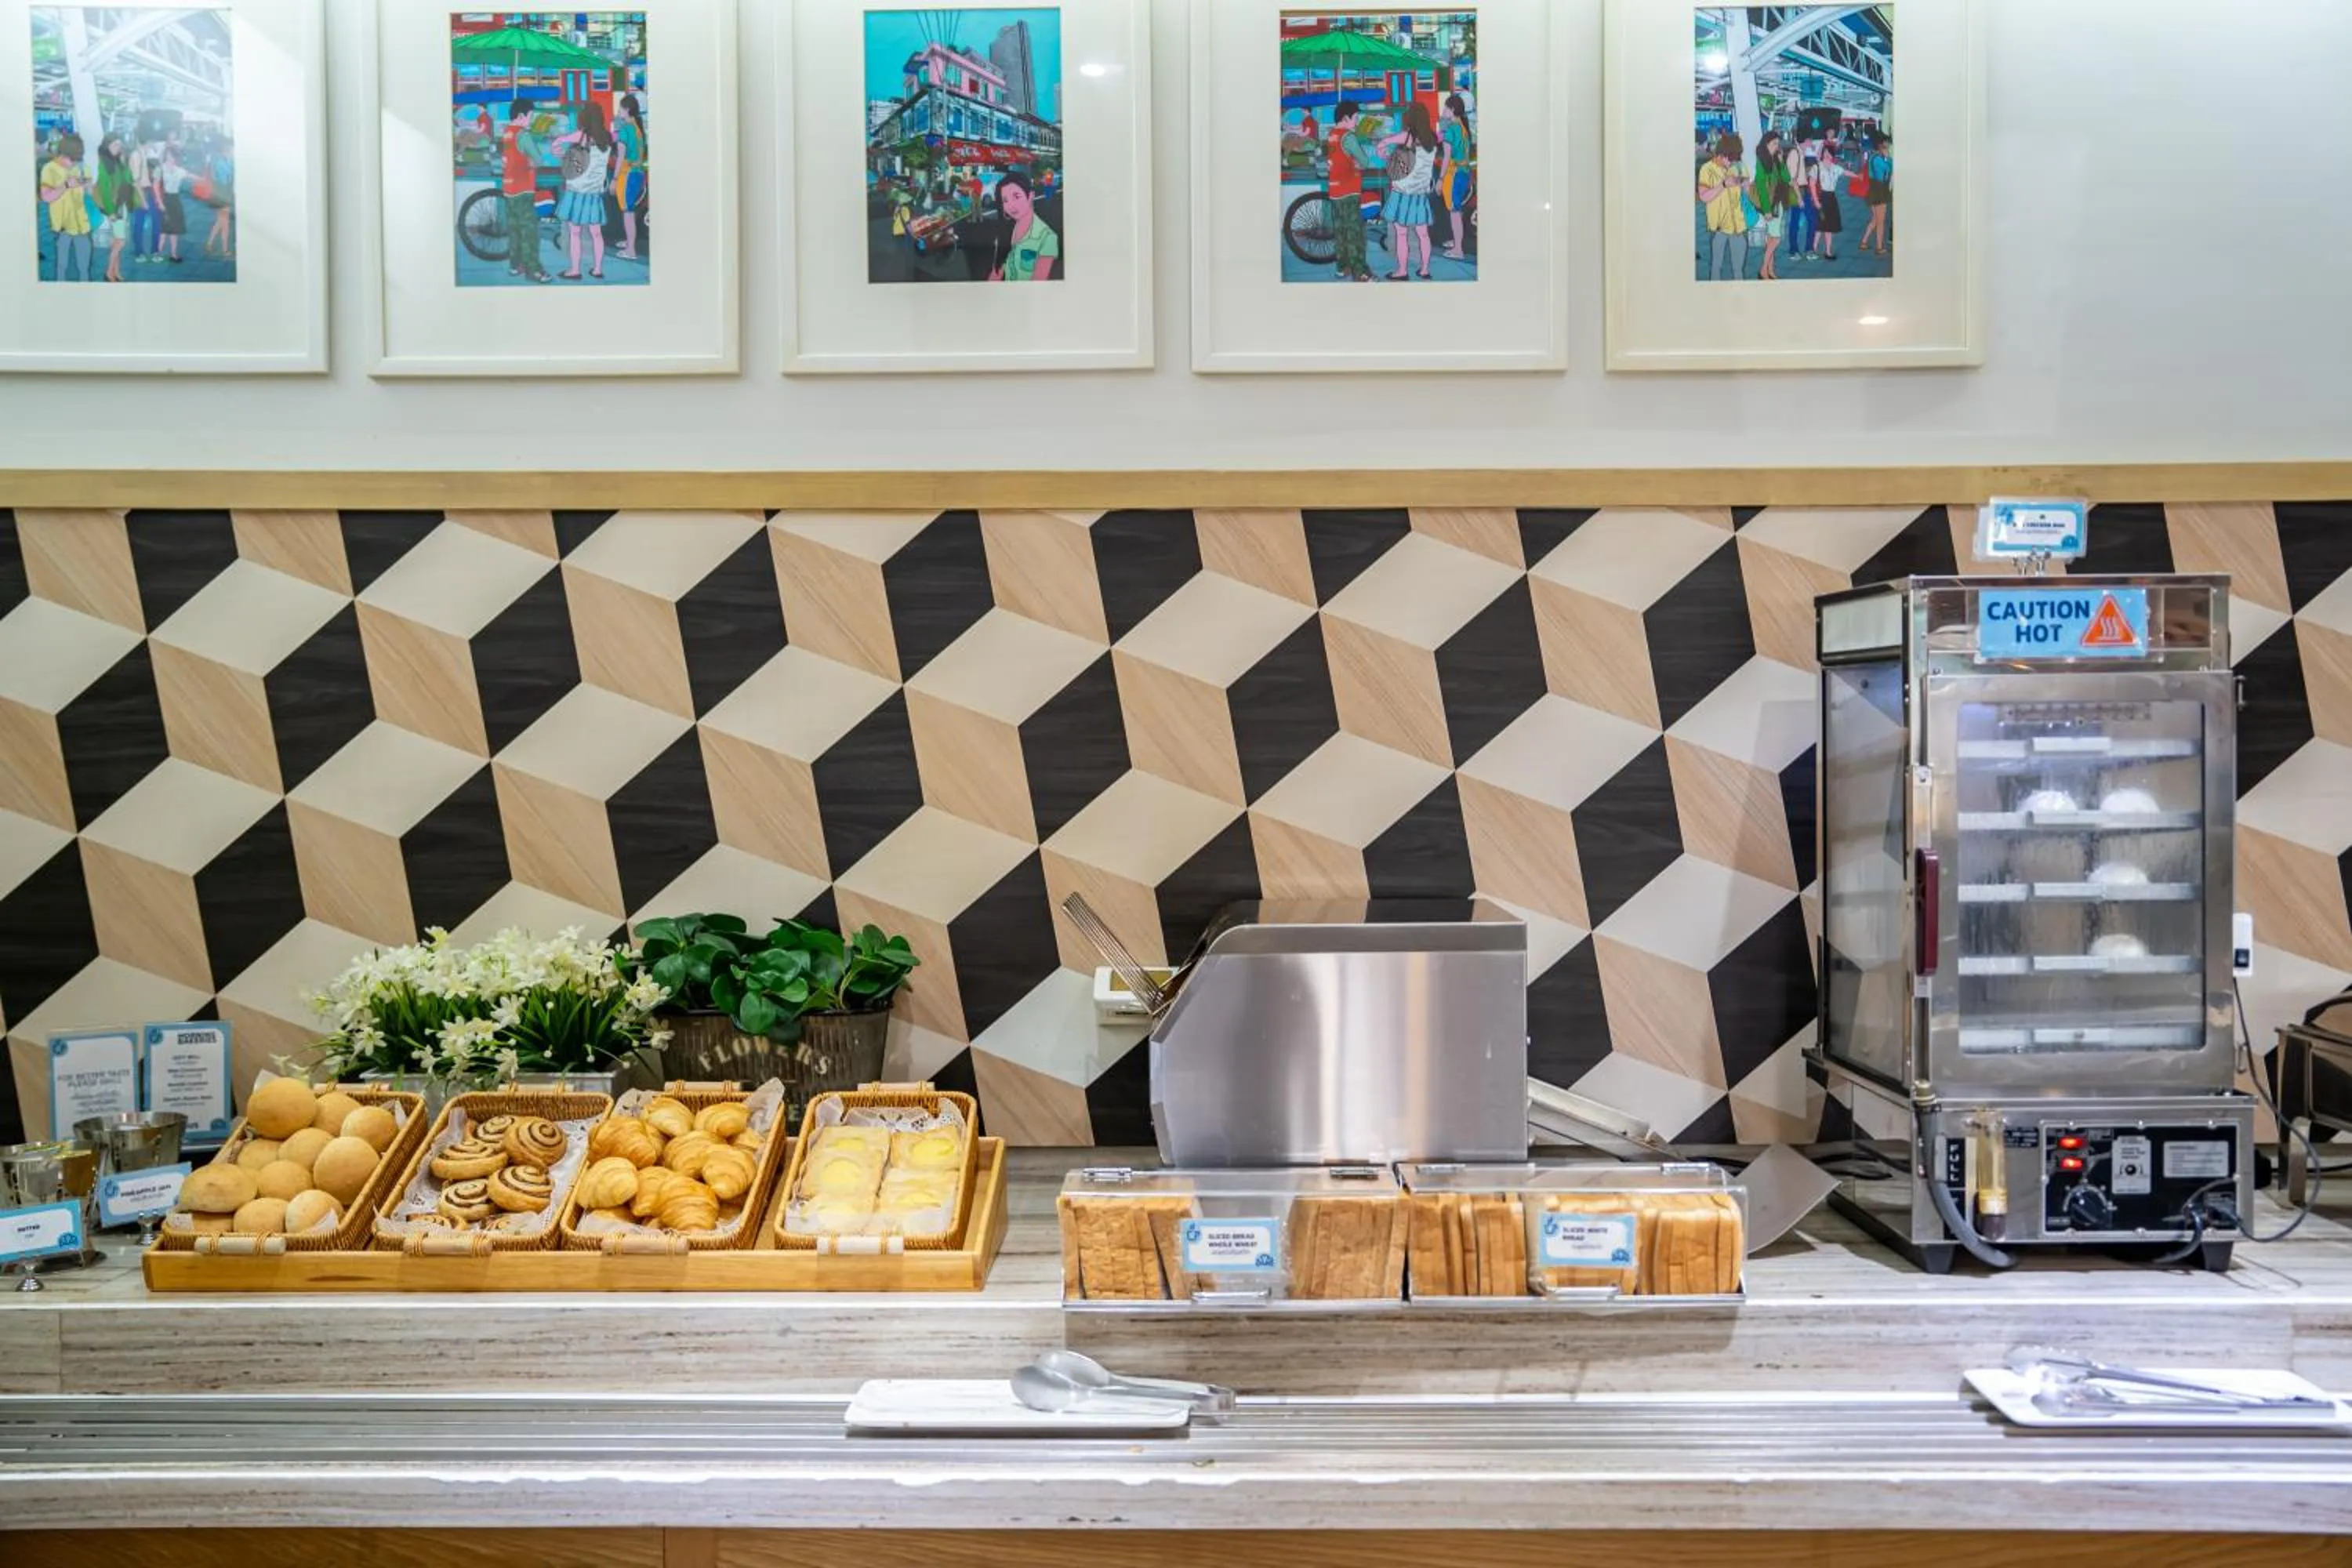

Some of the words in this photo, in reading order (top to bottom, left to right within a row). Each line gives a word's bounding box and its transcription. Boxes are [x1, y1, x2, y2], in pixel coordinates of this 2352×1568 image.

[1987, 600, 2090, 620] CAUTION
[2016, 624, 2062, 643] HOT
[697, 1035, 832, 1076] FLOWERS
